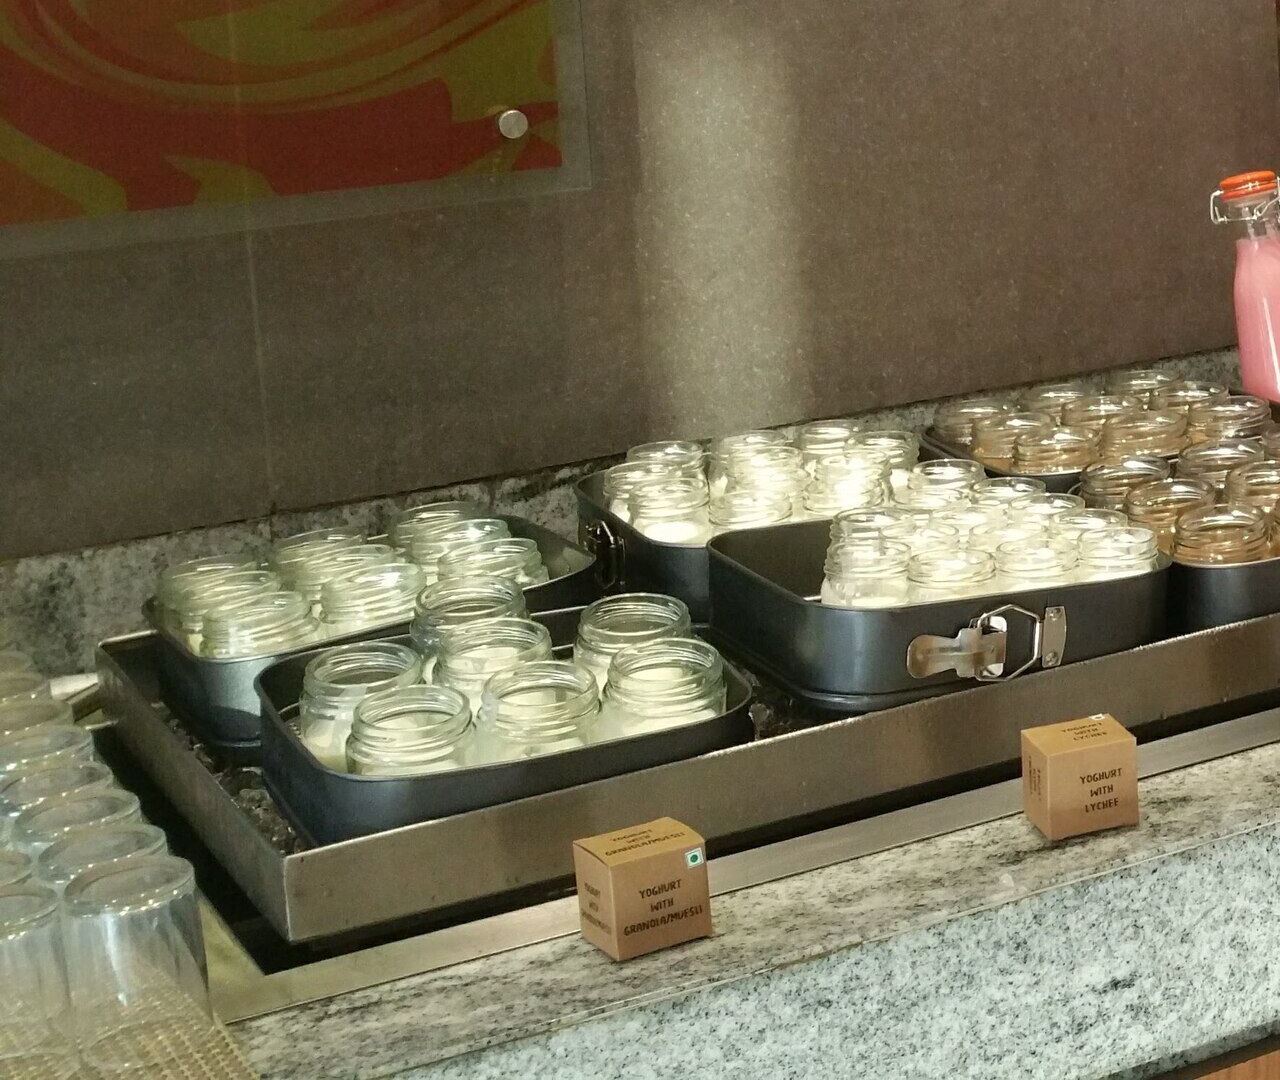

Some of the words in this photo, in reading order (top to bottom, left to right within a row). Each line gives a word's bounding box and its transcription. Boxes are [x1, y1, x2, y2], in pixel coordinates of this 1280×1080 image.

[1079, 768, 1123, 784] YOGHURT
[1090, 784, 1114, 798] WITH
[1085, 797, 1119, 813] LYCHEE
[638, 878, 682, 899] YOGHURT
[650, 897, 674, 913] WITH
